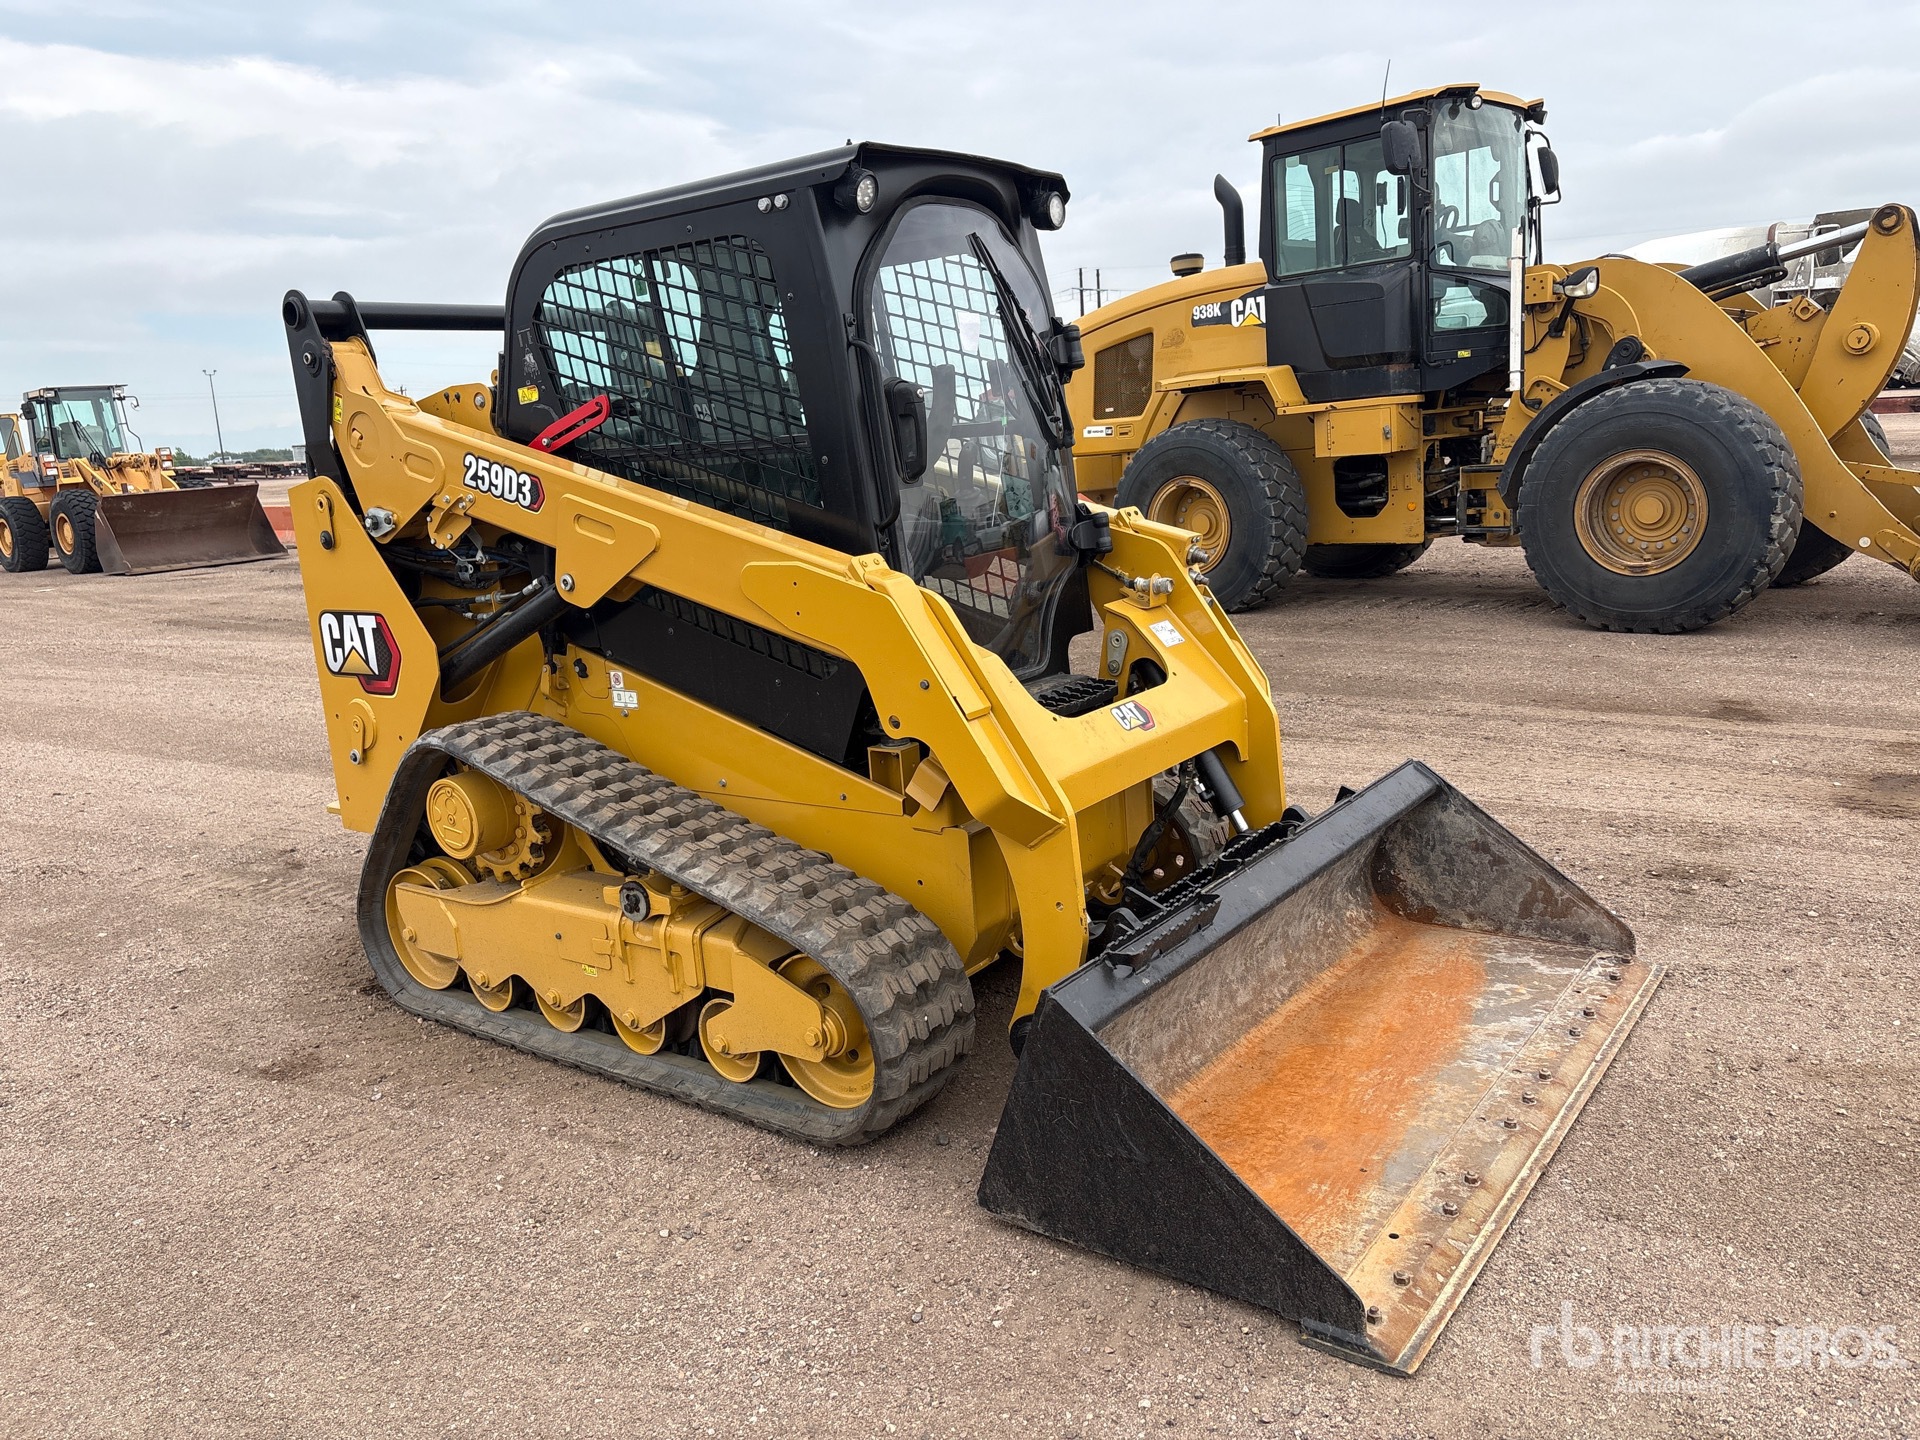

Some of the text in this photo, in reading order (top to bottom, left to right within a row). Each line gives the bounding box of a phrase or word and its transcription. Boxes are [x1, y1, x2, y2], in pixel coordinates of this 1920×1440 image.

[1193, 295, 1266, 328] 938K CAT
[463, 453, 532, 507] 259D3
[320, 612, 379, 676] CAT
[1111, 701, 1147, 730] CAT
